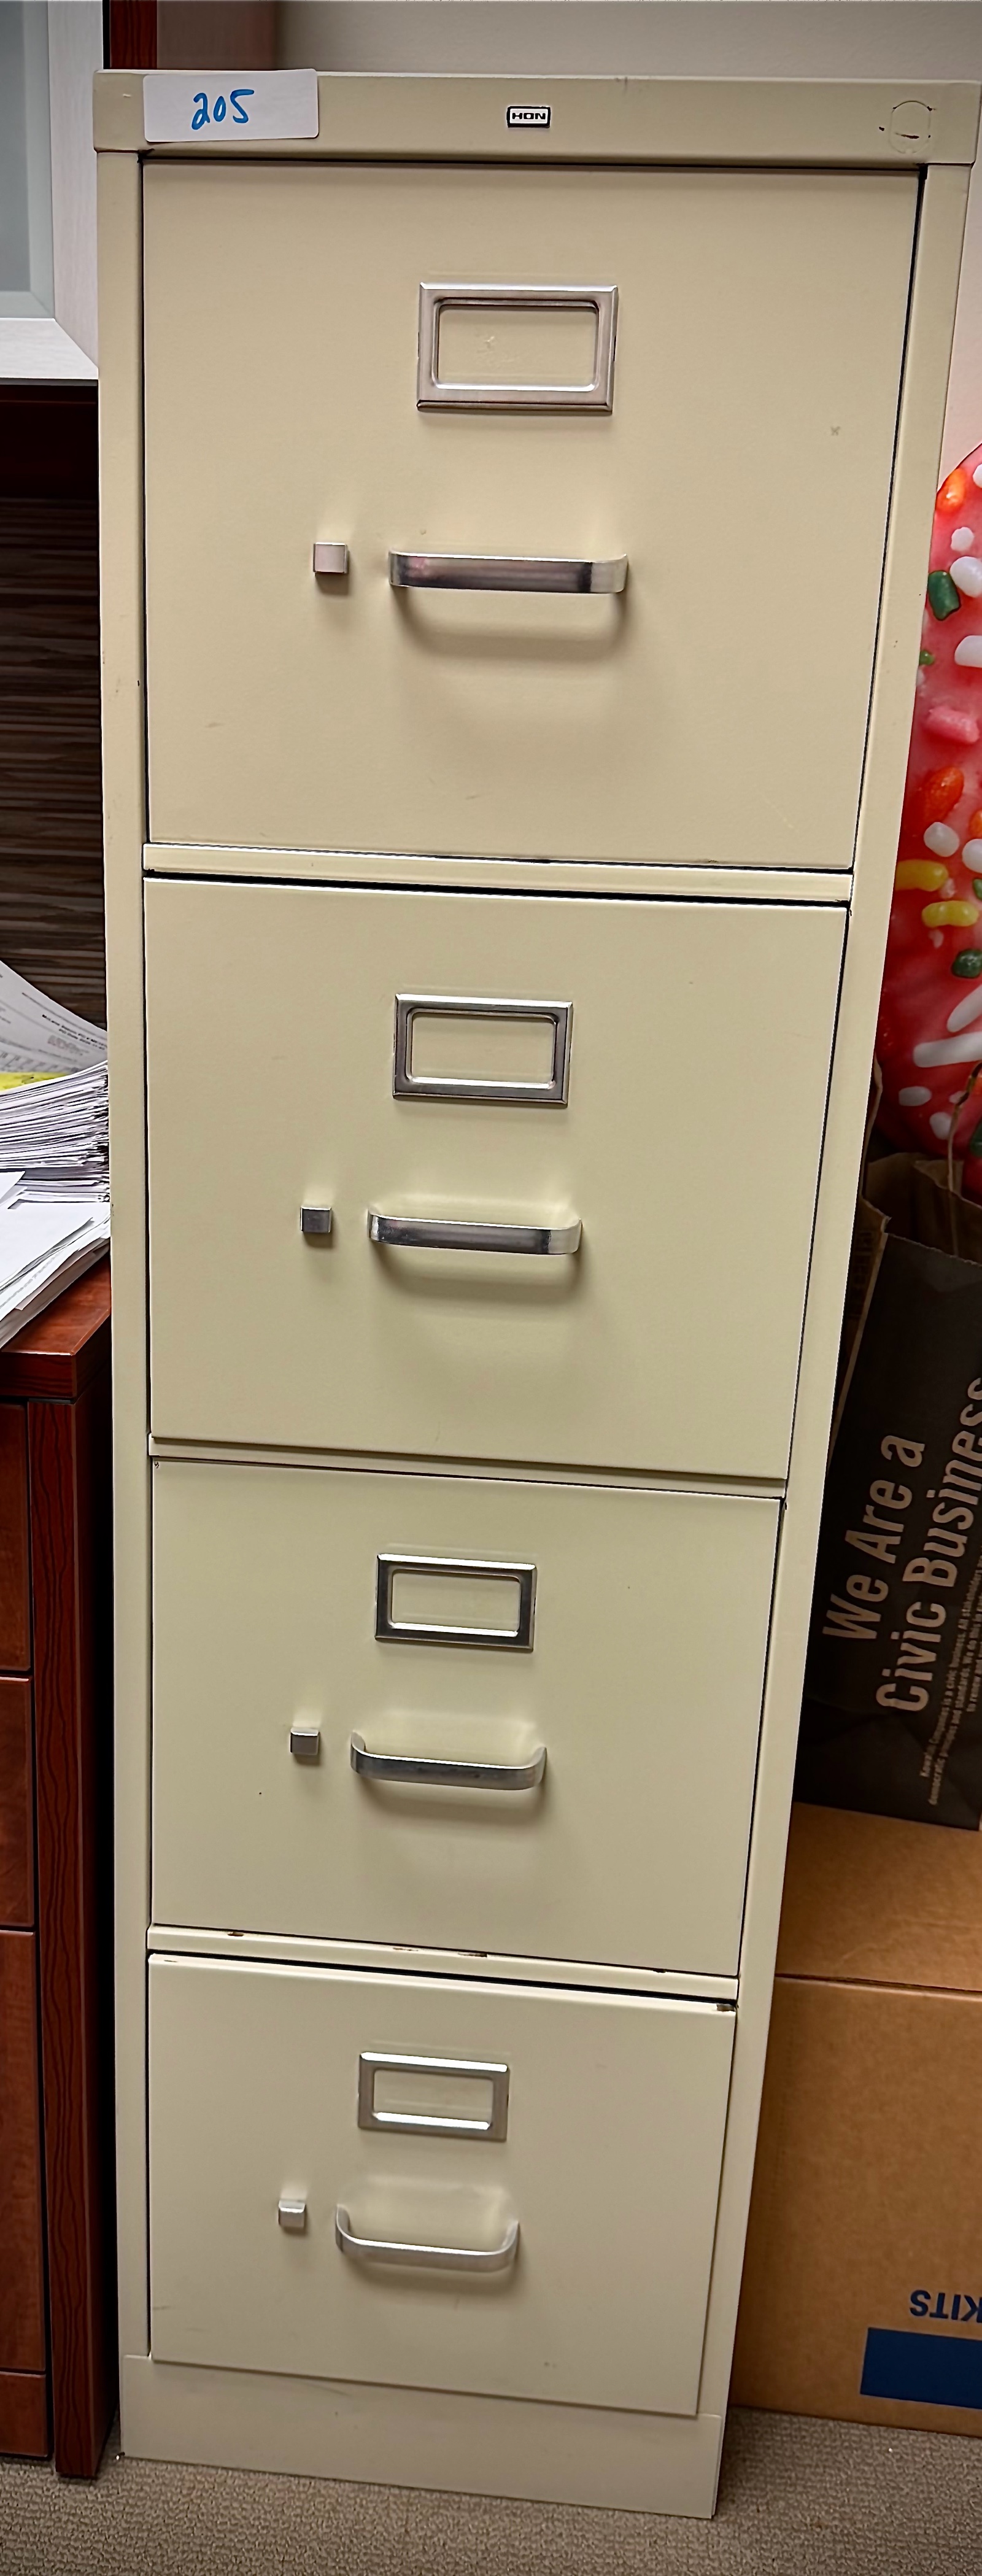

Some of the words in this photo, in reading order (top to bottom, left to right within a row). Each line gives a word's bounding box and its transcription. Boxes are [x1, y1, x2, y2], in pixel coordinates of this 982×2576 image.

[191, 89, 255, 130] 205
[881, 1435, 925, 1468] a
[845, 1480, 913, 1564] Are
[822, 1574, 889, 1639] We
[876, 1601, 946, 1712] Civic
[910, 2289, 982, 2323] KITS
